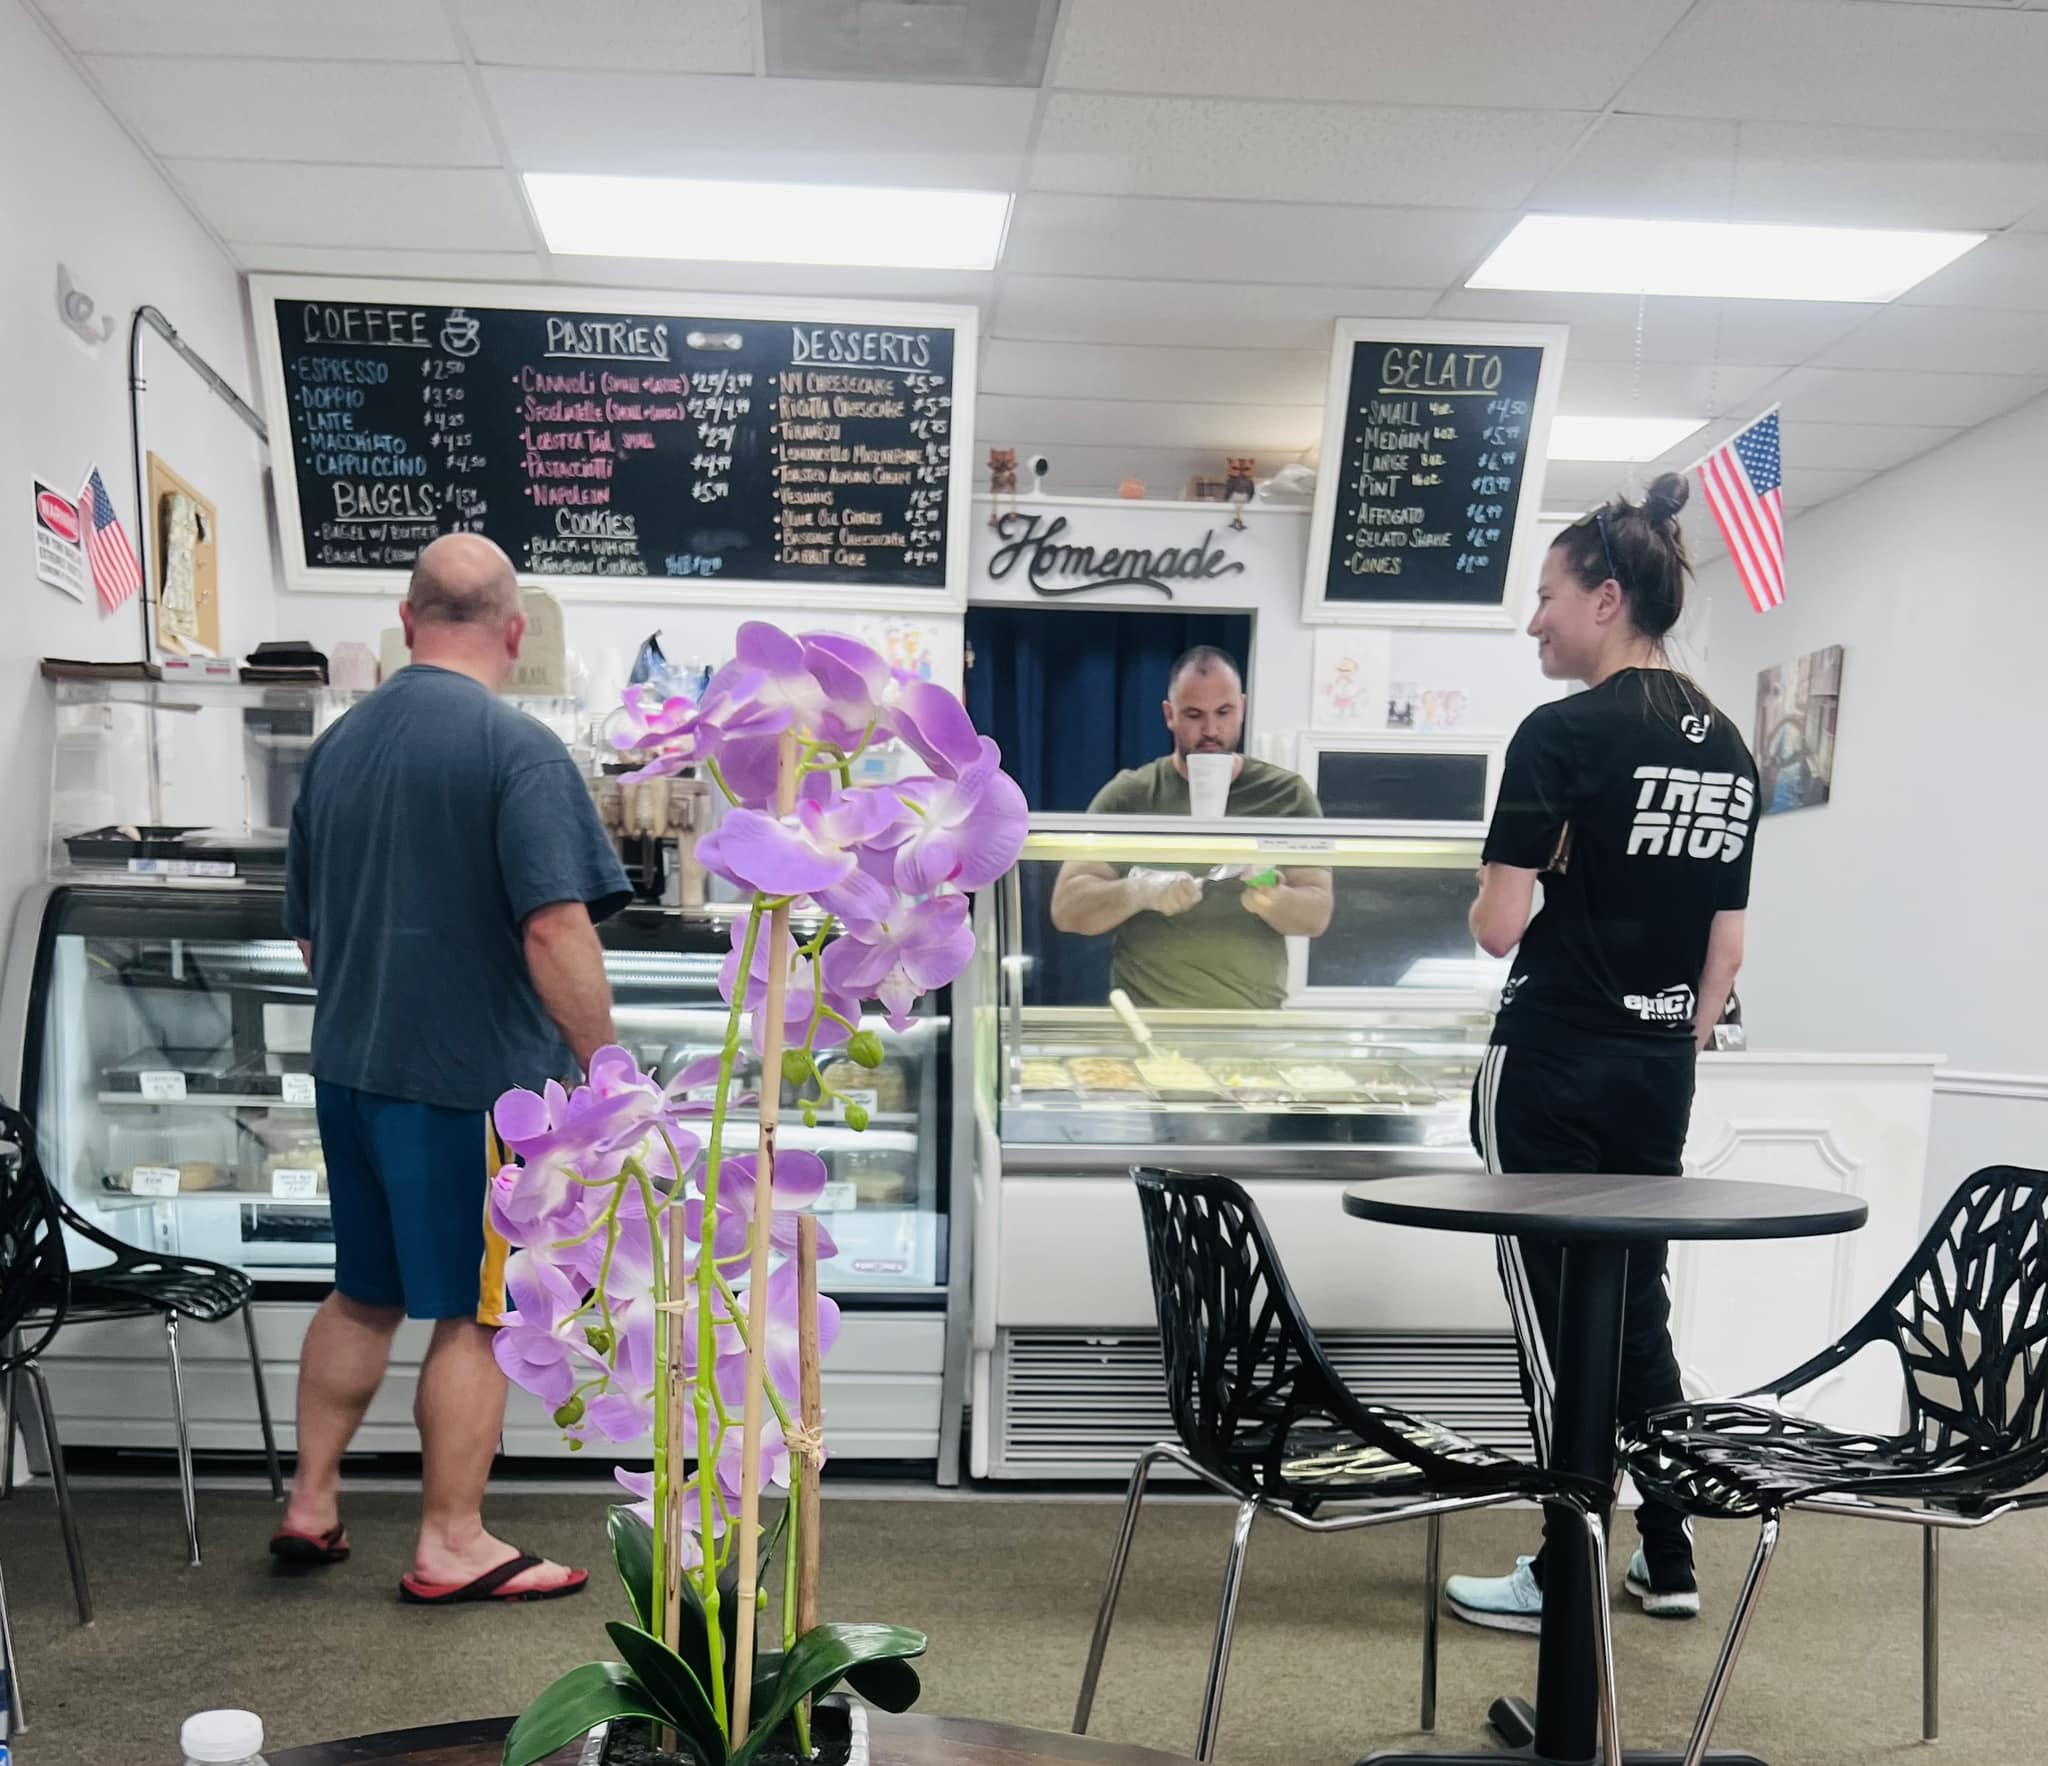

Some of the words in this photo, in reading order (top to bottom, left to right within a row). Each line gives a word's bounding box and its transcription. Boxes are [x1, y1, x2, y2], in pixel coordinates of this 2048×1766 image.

[303, 304, 428, 344] COFFEE
[792, 327, 930, 366] DESSERTS
[298, 357, 389, 384] ESPRESSO
[1382, 348, 1502, 389] GELATO
[779, 370, 803, 394] NY
[806, 371, 894, 396] CHEESECAKE
[307, 411, 353, 432] LATTE
[1368, 400, 1421, 426] SMALL
[1362, 452, 1409, 473] LARGE
[1357, 502, 1425, 526] AFFOGATO
[321, 523, 366, 541] BAGEL
[531, 536, 580, 554] BLACK
[1355, 528, 1407, 548] GELATO
[988, 512, 1245, 600] Homemade
[1351, 551, 1402, 575] CONES
[1632, 765, 1754, 821] TRES
